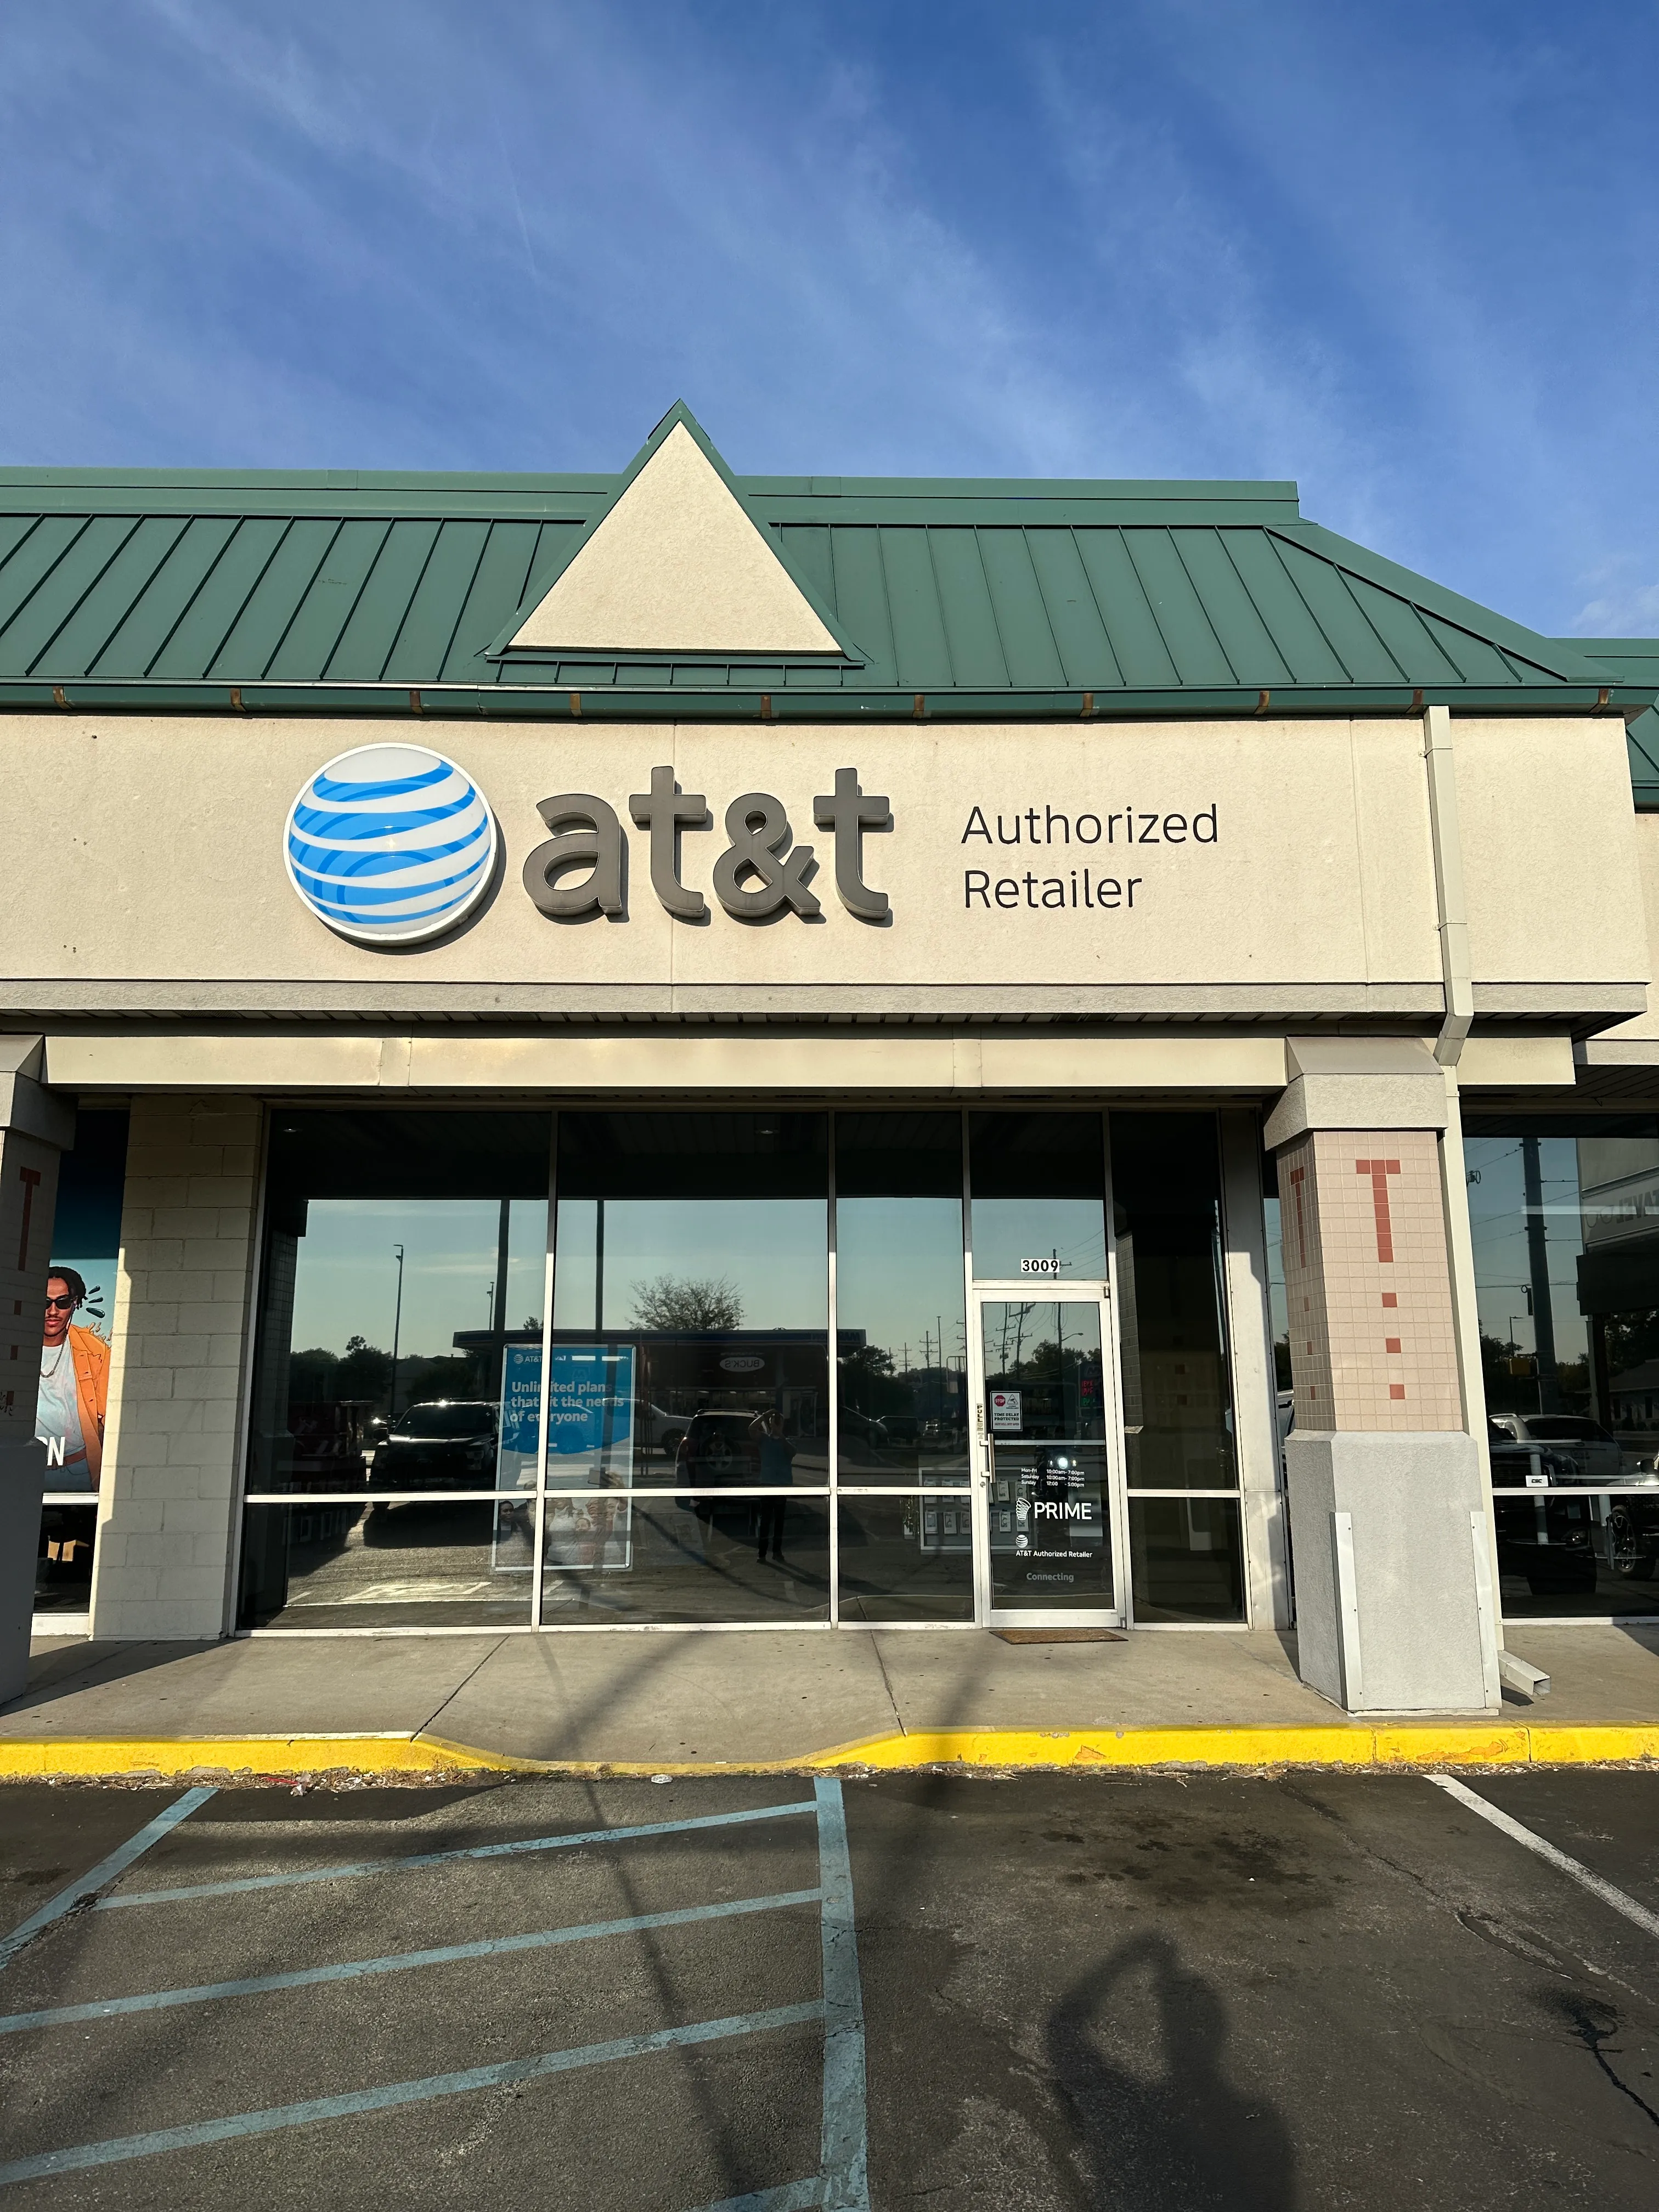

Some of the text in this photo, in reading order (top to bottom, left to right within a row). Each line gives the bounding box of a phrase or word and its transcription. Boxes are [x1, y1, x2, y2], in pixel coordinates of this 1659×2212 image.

[960, 804, 1218, 845] Authorized
[523, 766, 891, 923] at&t
[964, 869, 1143, 909] Retailer
[1022, 1260, 1058, 1272] 3009
[524, 1355, 543, 1363] AT&T
[578, 1381, 612, 1395] plans
[510, 1396, 539, 1407] that
[561, 1396, 583, 1407] the
[510, 1409, 588, 1425] of evryone
[1034, 1502, 1092, 1520] PRIME
[1026, 1572, 1074, 1583] Connecting
